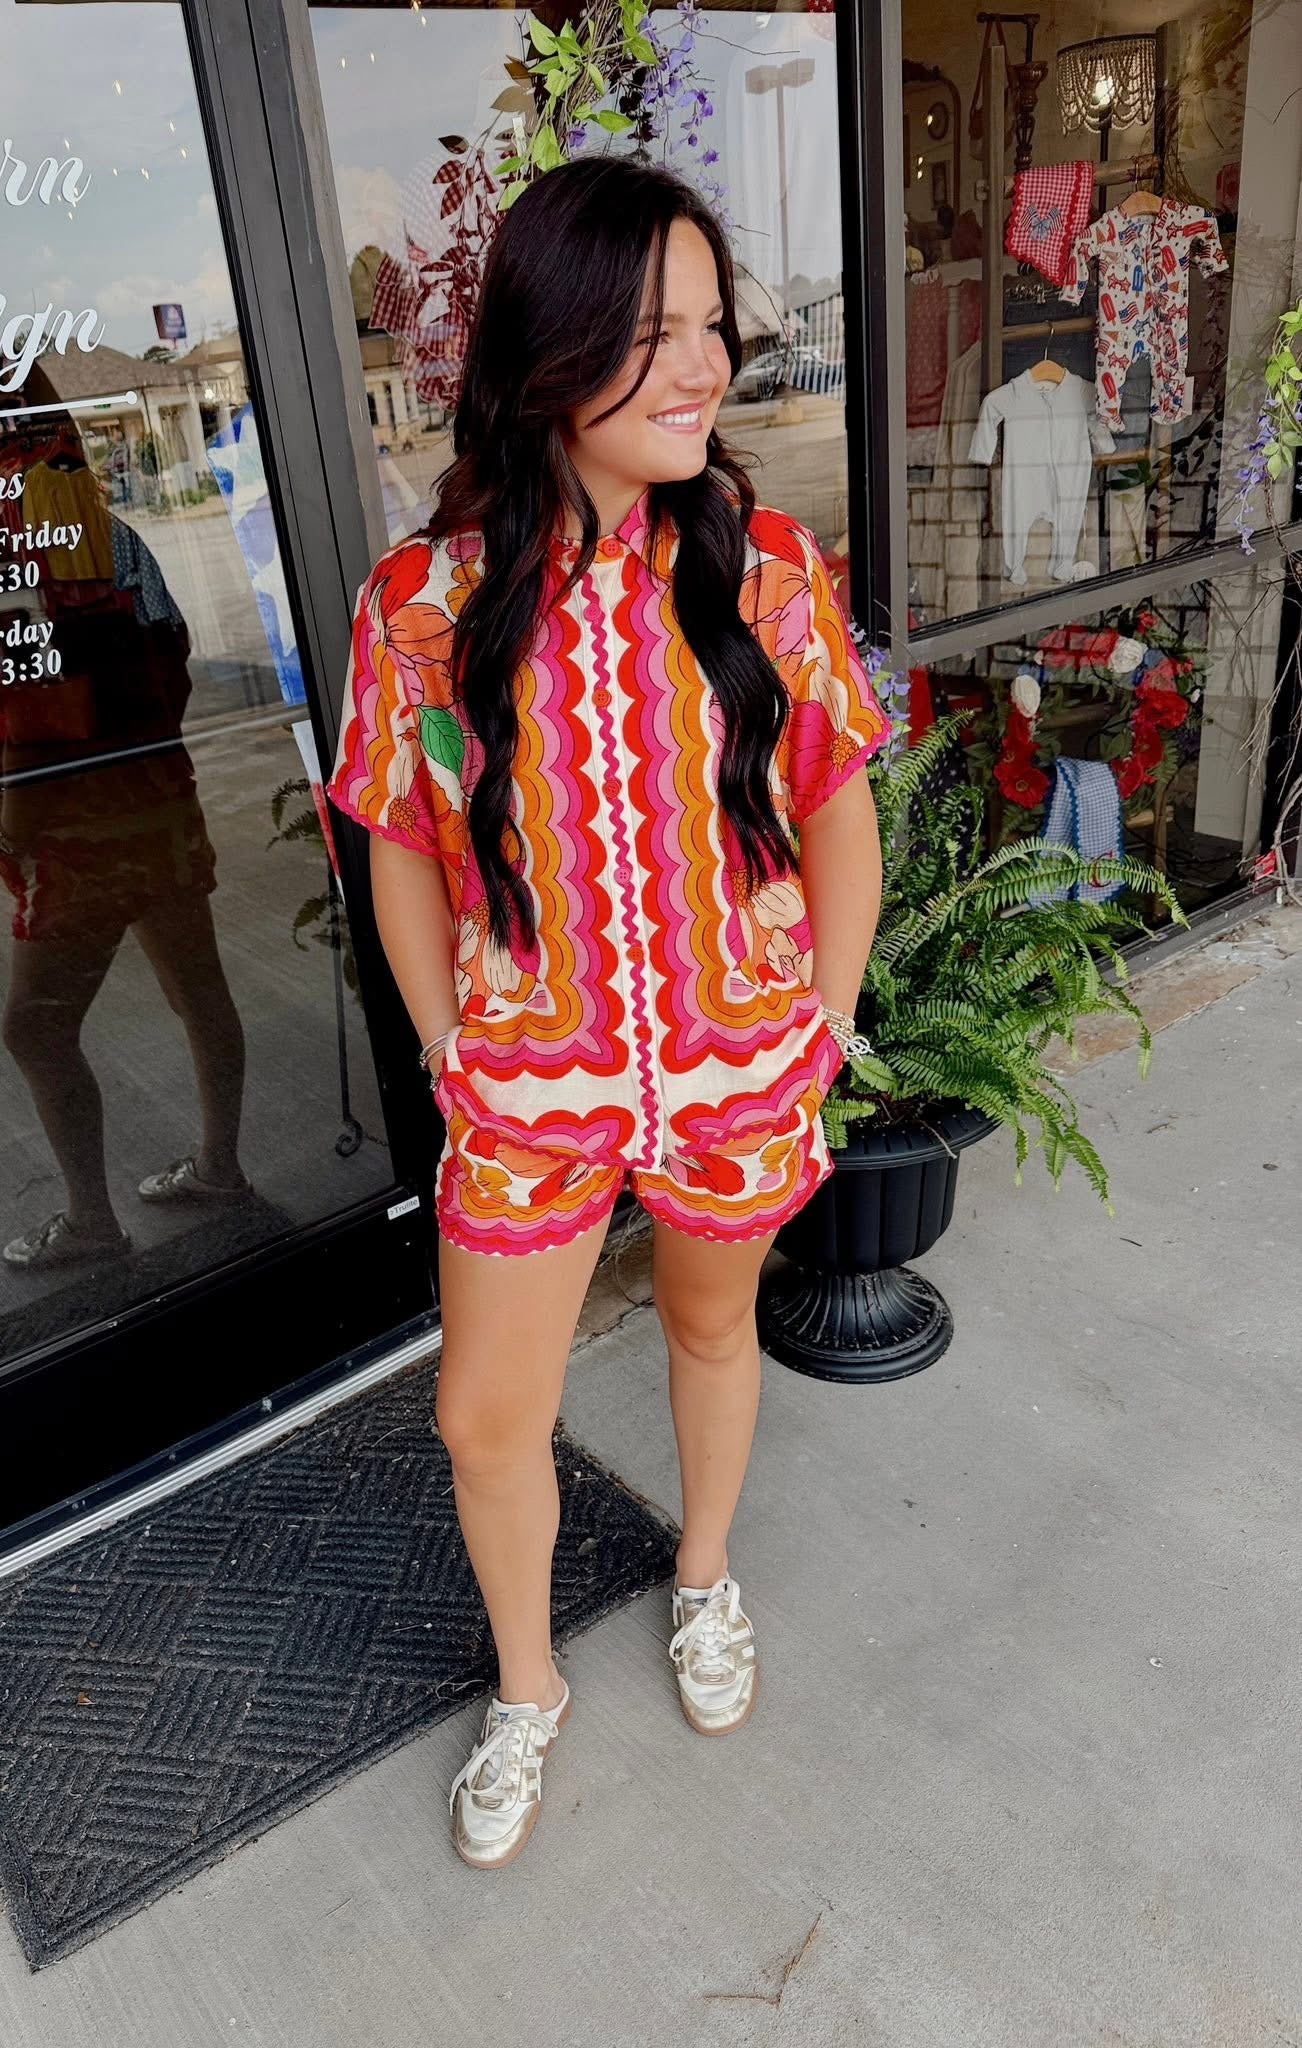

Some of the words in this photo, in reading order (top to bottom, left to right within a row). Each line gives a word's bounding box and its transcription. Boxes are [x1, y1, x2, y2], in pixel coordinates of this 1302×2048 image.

[0, 293, 106, 393] gn
[0, 619, 54, 648] day
[1, 649, 62, 686] 3:30
